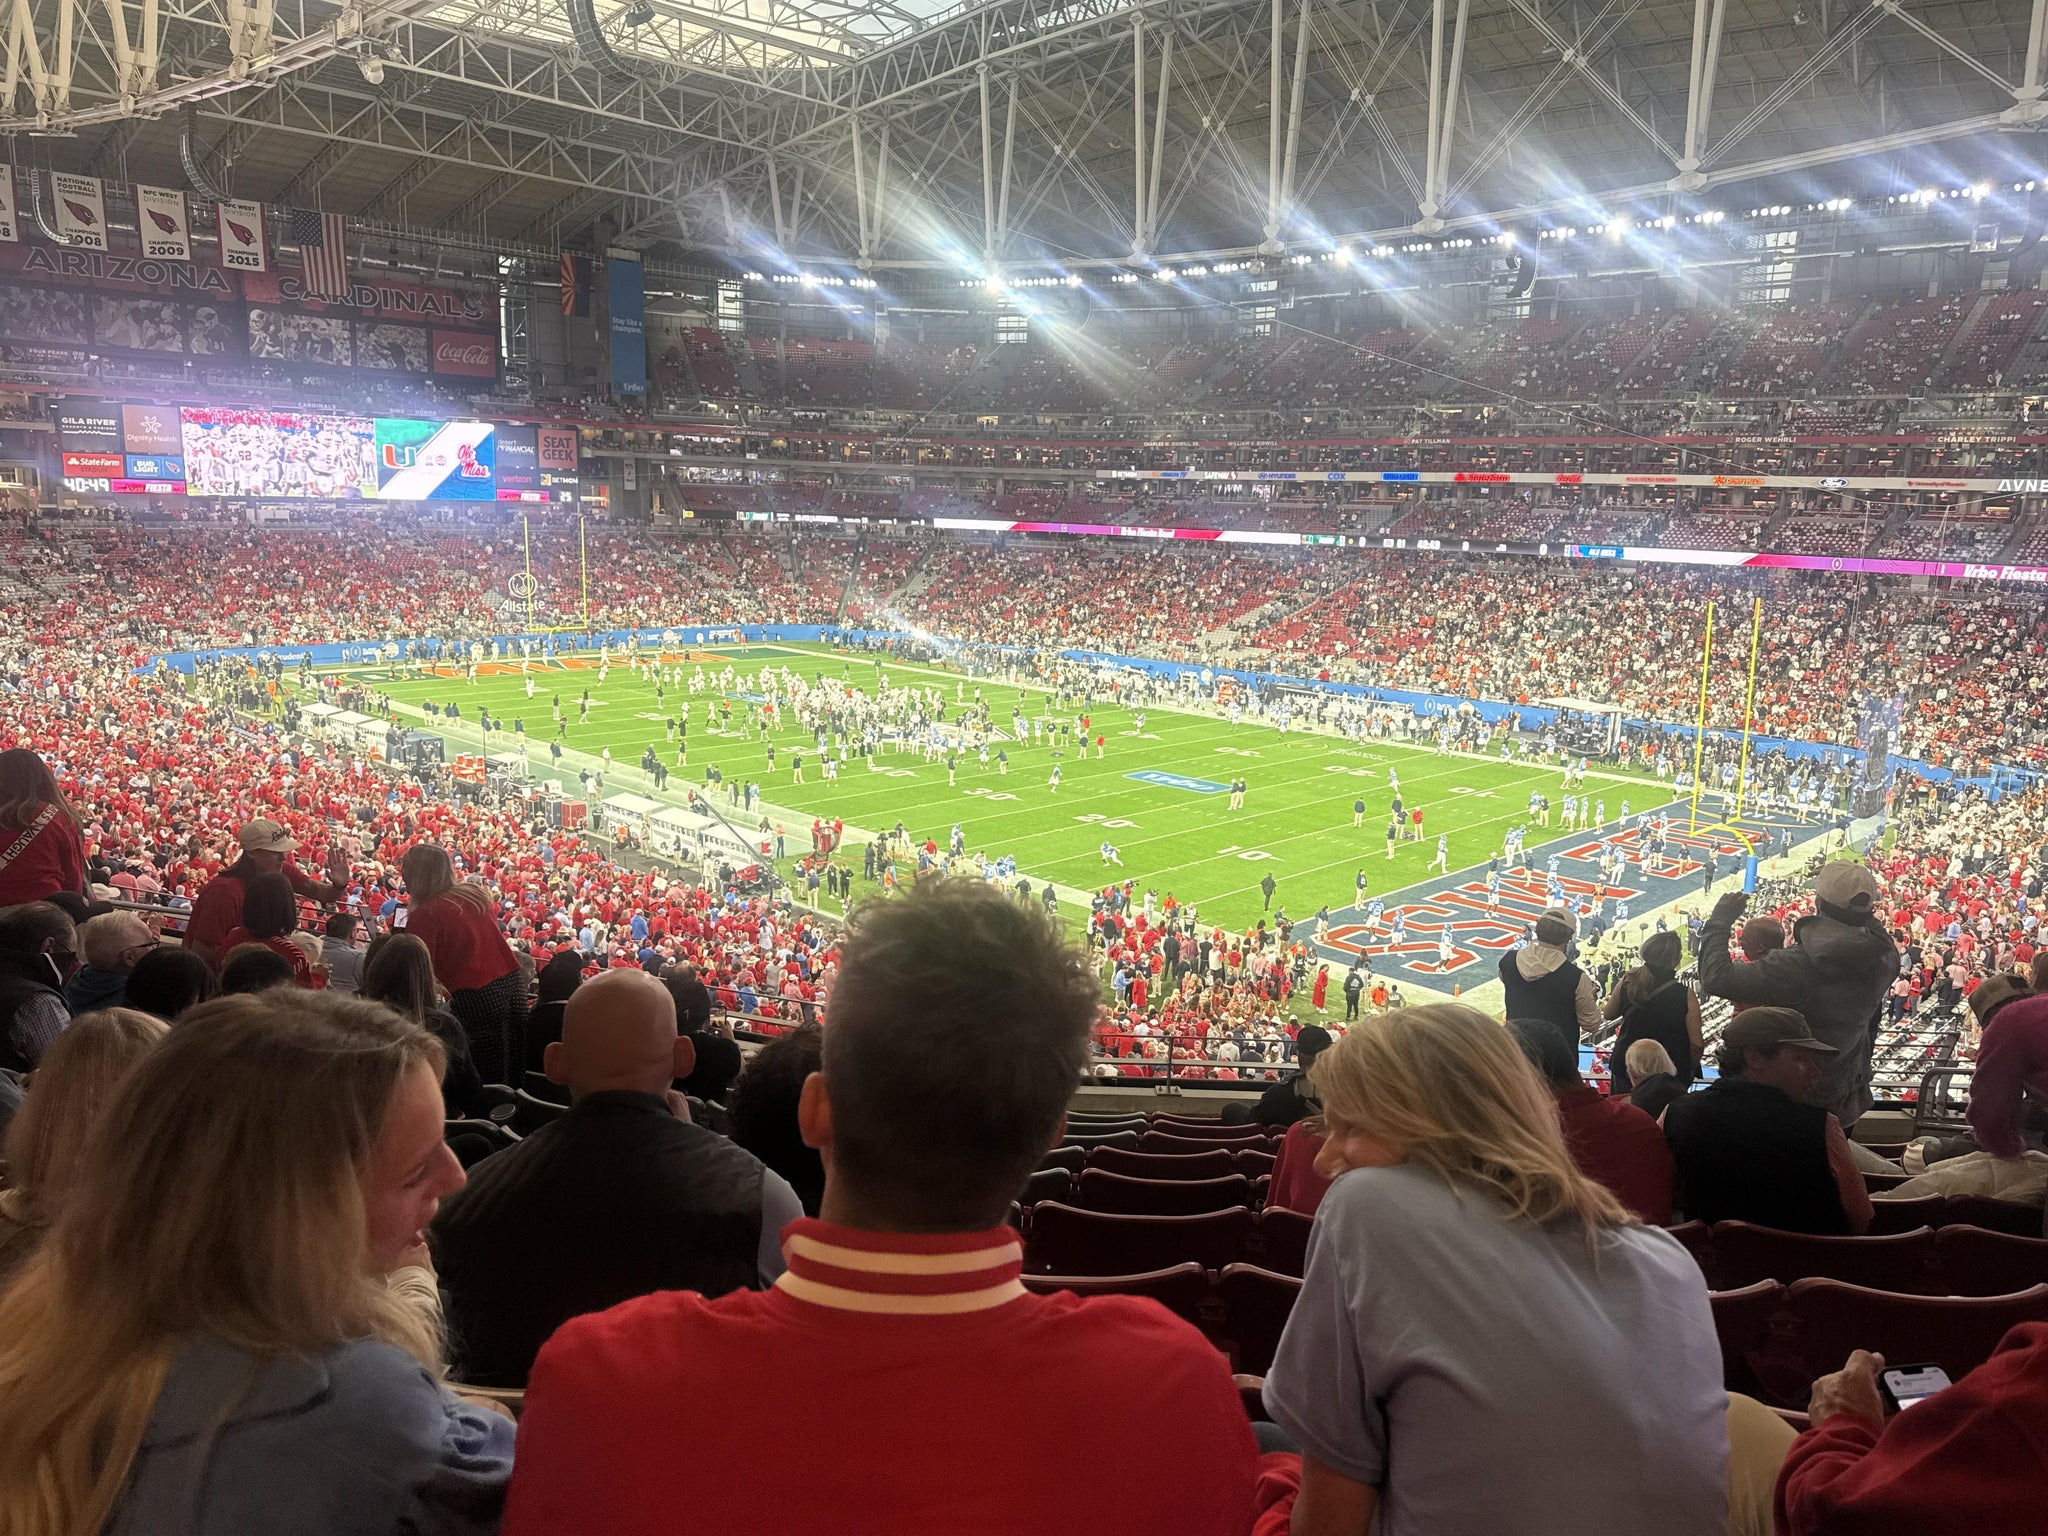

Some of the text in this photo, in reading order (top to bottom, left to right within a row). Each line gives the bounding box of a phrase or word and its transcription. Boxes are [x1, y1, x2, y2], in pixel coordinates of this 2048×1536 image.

[57, 176, 96, 187] NATIONAL
[57, 183, 96, 193] FOOTBALL
[58, 189, 97, 198] CONFERENCE
[143, 196, 179, 206] DIVISION
[224, 208, 257, 218] DIVISION
[65, 227, 101, 236] CHAMPIONS
[149, 246, 184, 256] 2009
[227, 254, 260, 267] 2015
[22, 246, 231, 292] ARIZONA
[612, 316, 626, 326] Stay
[437, 343, 491, 365] Coca-Cola
[623, 383, 643, 391] Vrbo
[61, 417, 116, 426] GILA RIVER
[127, 434, 152, 443] Dignity
[543, 436, 572, 449] SEAT
[238, 450, 251, 461] 62
[457, 444, 475, 460] Ole
[542, 449, 573, 461] GEEK
[461, 460, 489, 477] Miss
[502, 475, 532, 484] verizon
[1204, 471, 1229, 480] SAFEWAY
[1327, 472, 1346, 480] COX
[63, 478, 110, 492] 40:49
[1825, 479, 1842, 487] Ford
[1999, 566, 2048, 581] Fiesta
[963, 787, 1018, 801] 30
[1073, 813, 1133, 829] 20
[1216, 844, 1272, 861] 10
